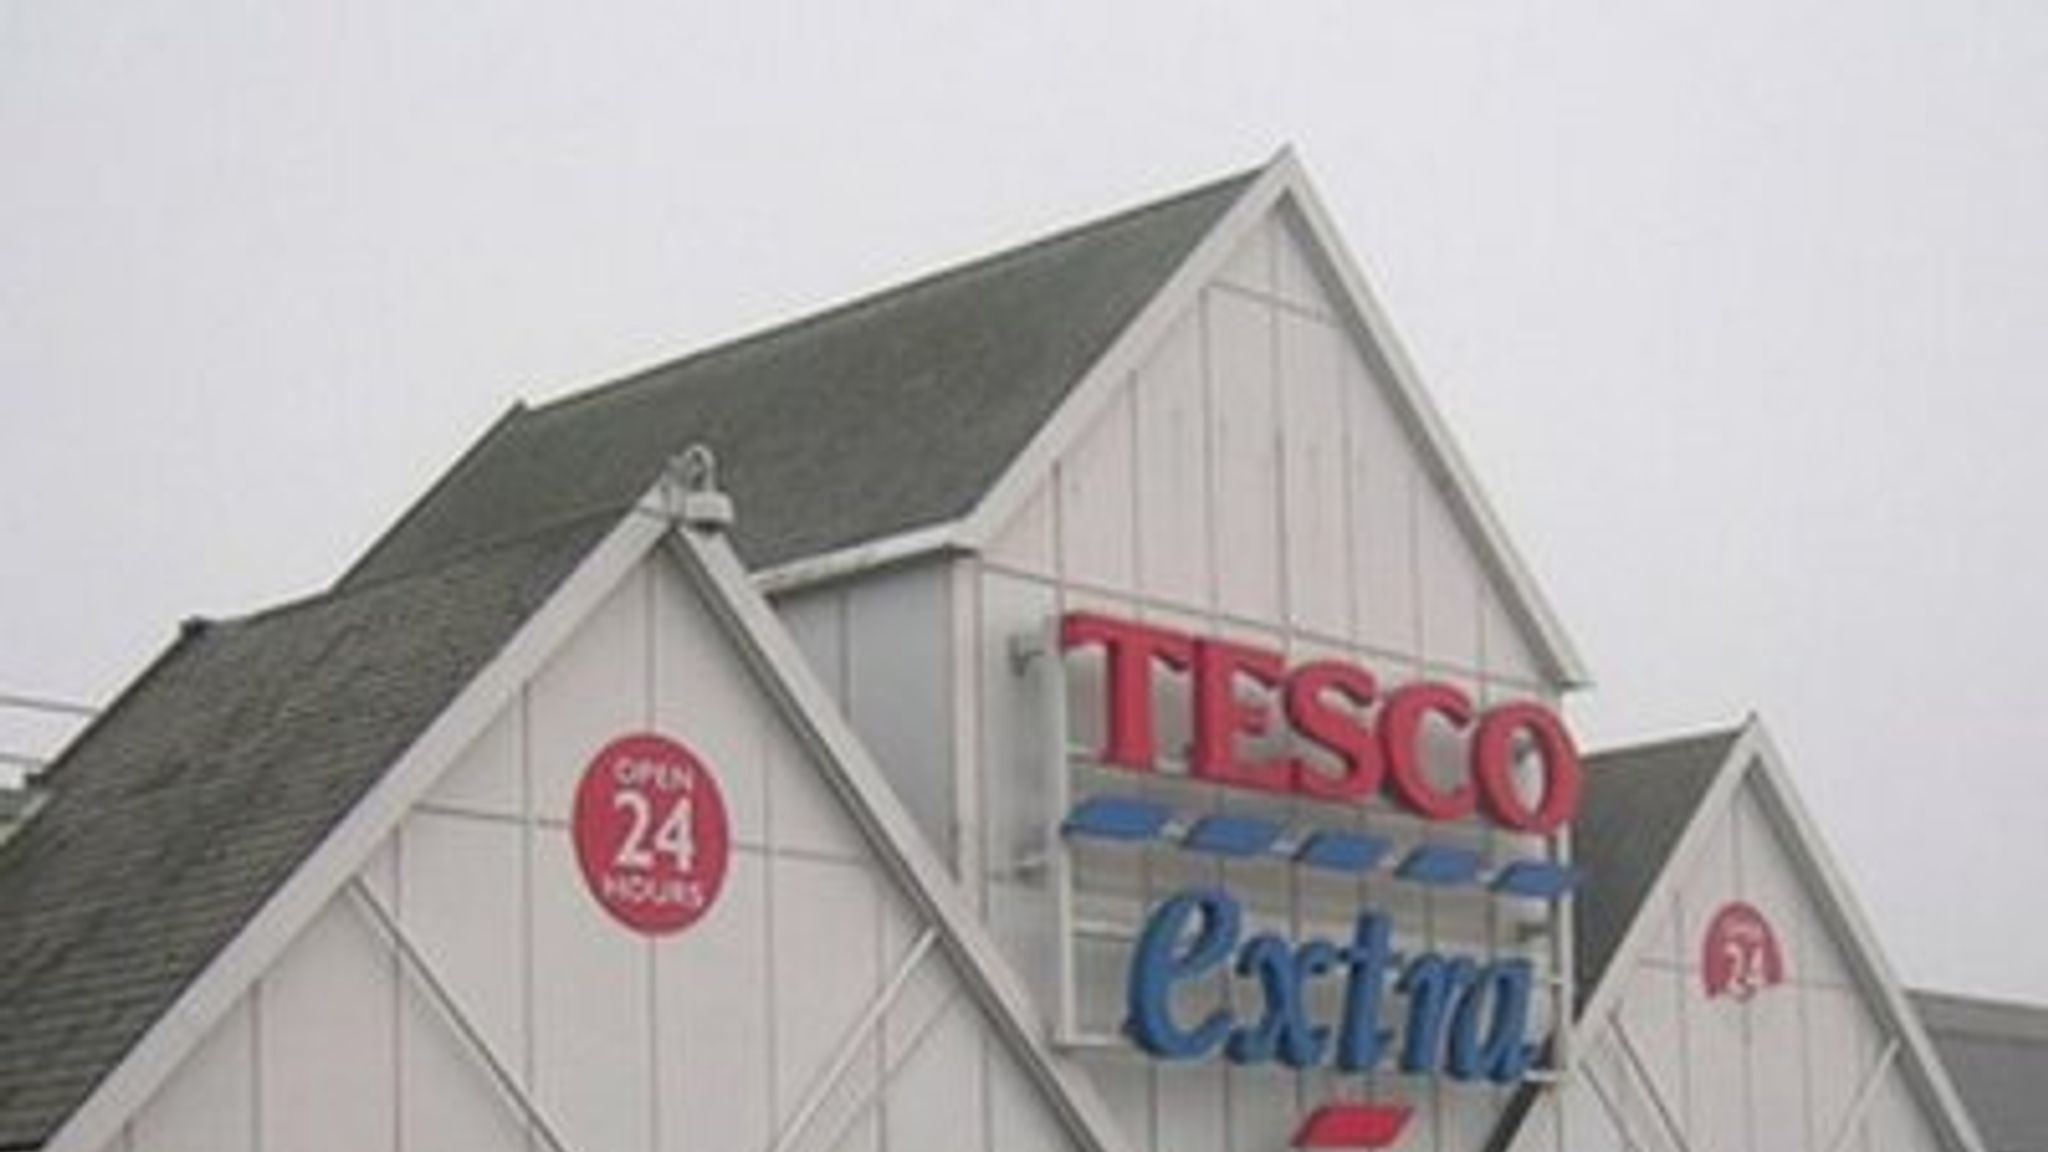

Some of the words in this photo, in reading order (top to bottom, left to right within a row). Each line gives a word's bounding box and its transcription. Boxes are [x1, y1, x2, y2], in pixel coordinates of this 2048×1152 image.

[1062, 612, 1582, 834] TESCO
[613, 757, 694, 790] OPEN
[613, 791, 695, 872] 24
[602, 873, 703, 908] HOURS
[1122, 886, 1540, 1084] extra
[1723, 941, 1767, 995] 24
